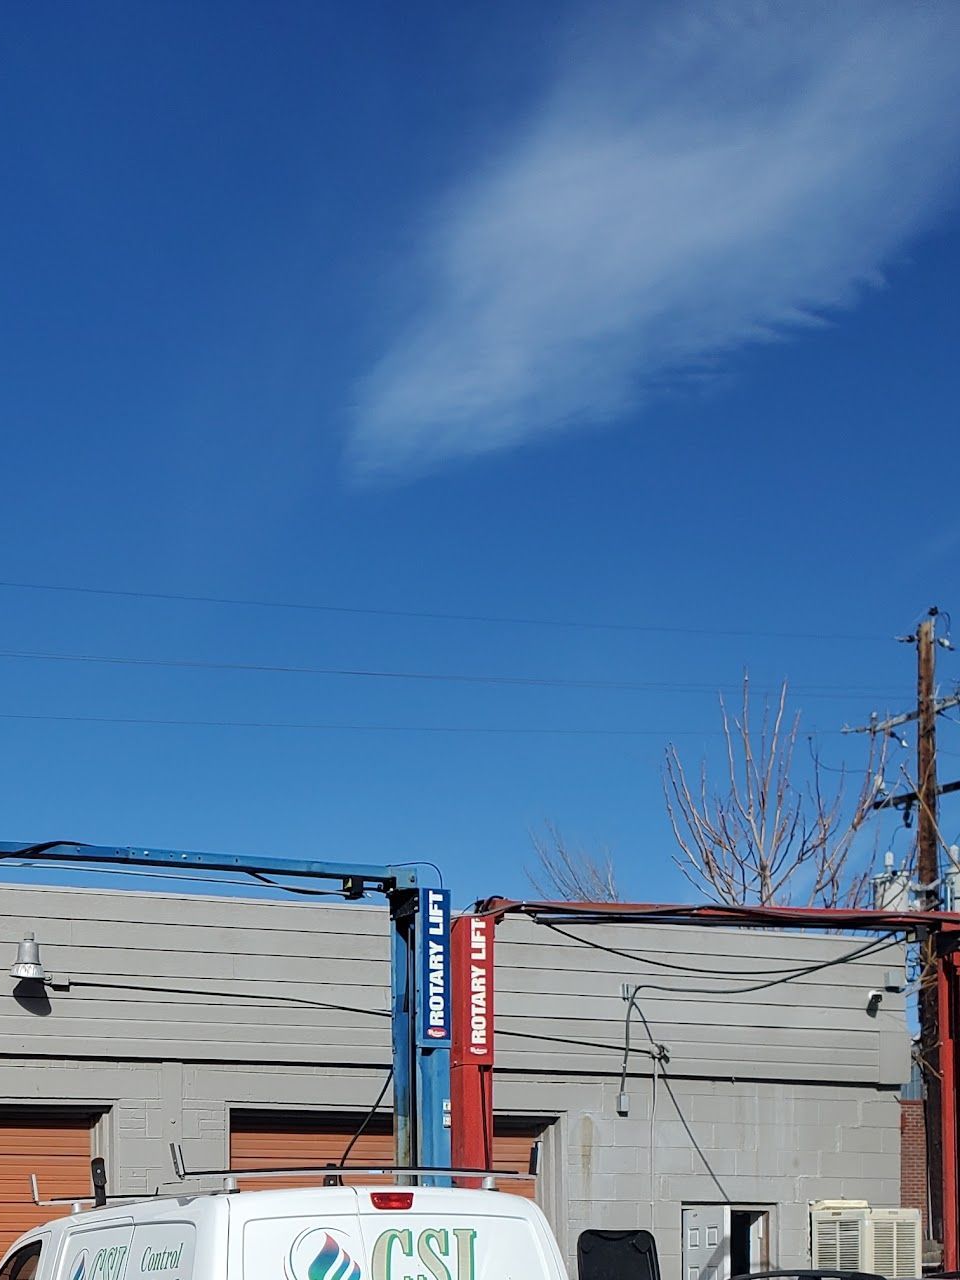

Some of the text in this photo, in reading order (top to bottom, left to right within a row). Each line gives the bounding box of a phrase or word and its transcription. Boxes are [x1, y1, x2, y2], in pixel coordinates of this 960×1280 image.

[428, 890, 445, 937] LIFT
[470, 917, 487, 961] LIFT
[428, 940, 445, 1027] ROTARY
[470, 964, 487, 1045] ROTARY
[141, 1242, 184, 1273] Control
